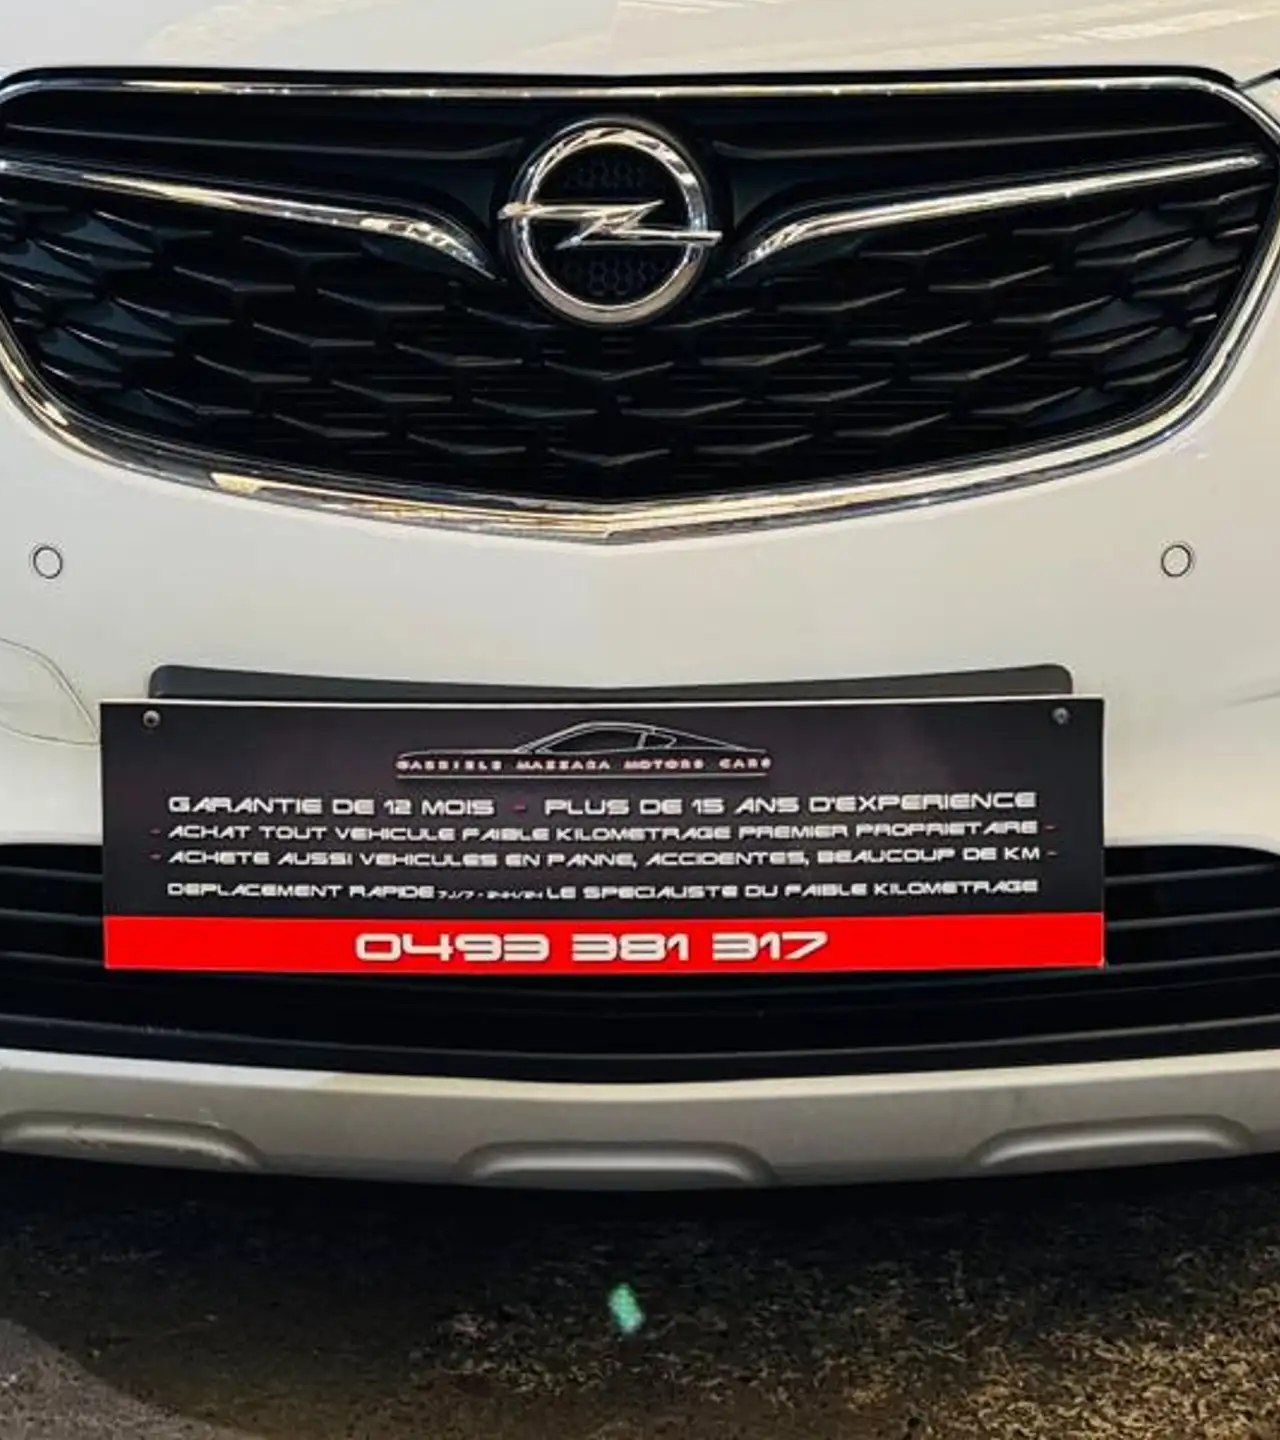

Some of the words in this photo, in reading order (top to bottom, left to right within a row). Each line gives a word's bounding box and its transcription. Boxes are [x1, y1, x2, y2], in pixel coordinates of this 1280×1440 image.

[624, 758, 704, 770] MOTORS
[719, 757, 772, 770] CARS
[168, 797, 323, 815] GARANTIE
[332, 799, 375, 815] DE
[383, 799, 412, 815] 12
[421, 799, 495, 816] MOIS
[544, 799, 630, 815] PLUS
[639, 799, 683, 815] DE
[691, 799, 725, 815] 15
[734, 797, 800, 813] ANS
[809, 791, 1037, 813] D'EXPERIENCE
[168, 825, 251, 839] ACHAT
[259, 826, 327, 840] TOUT
[335, 827, 456, 841] VEHICULE
[462, 828, 550, 841] FAIBLE
[556, 826, 731, 841] KILOMETRAGE
[738, 823, 848, 839] PREMIER
[169, 851, 270, 865] ACHETE
[277, 852, 353, 866] AUSSI
[360, 853, 498, 867] VEHICULES
[505, 854, 540, 867] EN
[547, 853, 638, 871] PANNE,
[646, 850, 809, 867] ACCIDENTES,
[817, 848, 955, 863] BEAUCOUP
[963, 847, 997, 861] DE
[167, 883, 343, 897] DEPLACEMENT
[349, 885, 435, 899] RAPIDE
[546, 886, 577, 899] LE
[745, 885, 778, 897] DU
[785, 883, 868, 897] FAIBLE
[874, 880, 1039, 895] KILOMETRAGE
[356, 933, 549, 961] 0493
[572, 933, 688, 961] 381
[712, 931, 828, 960] 317
